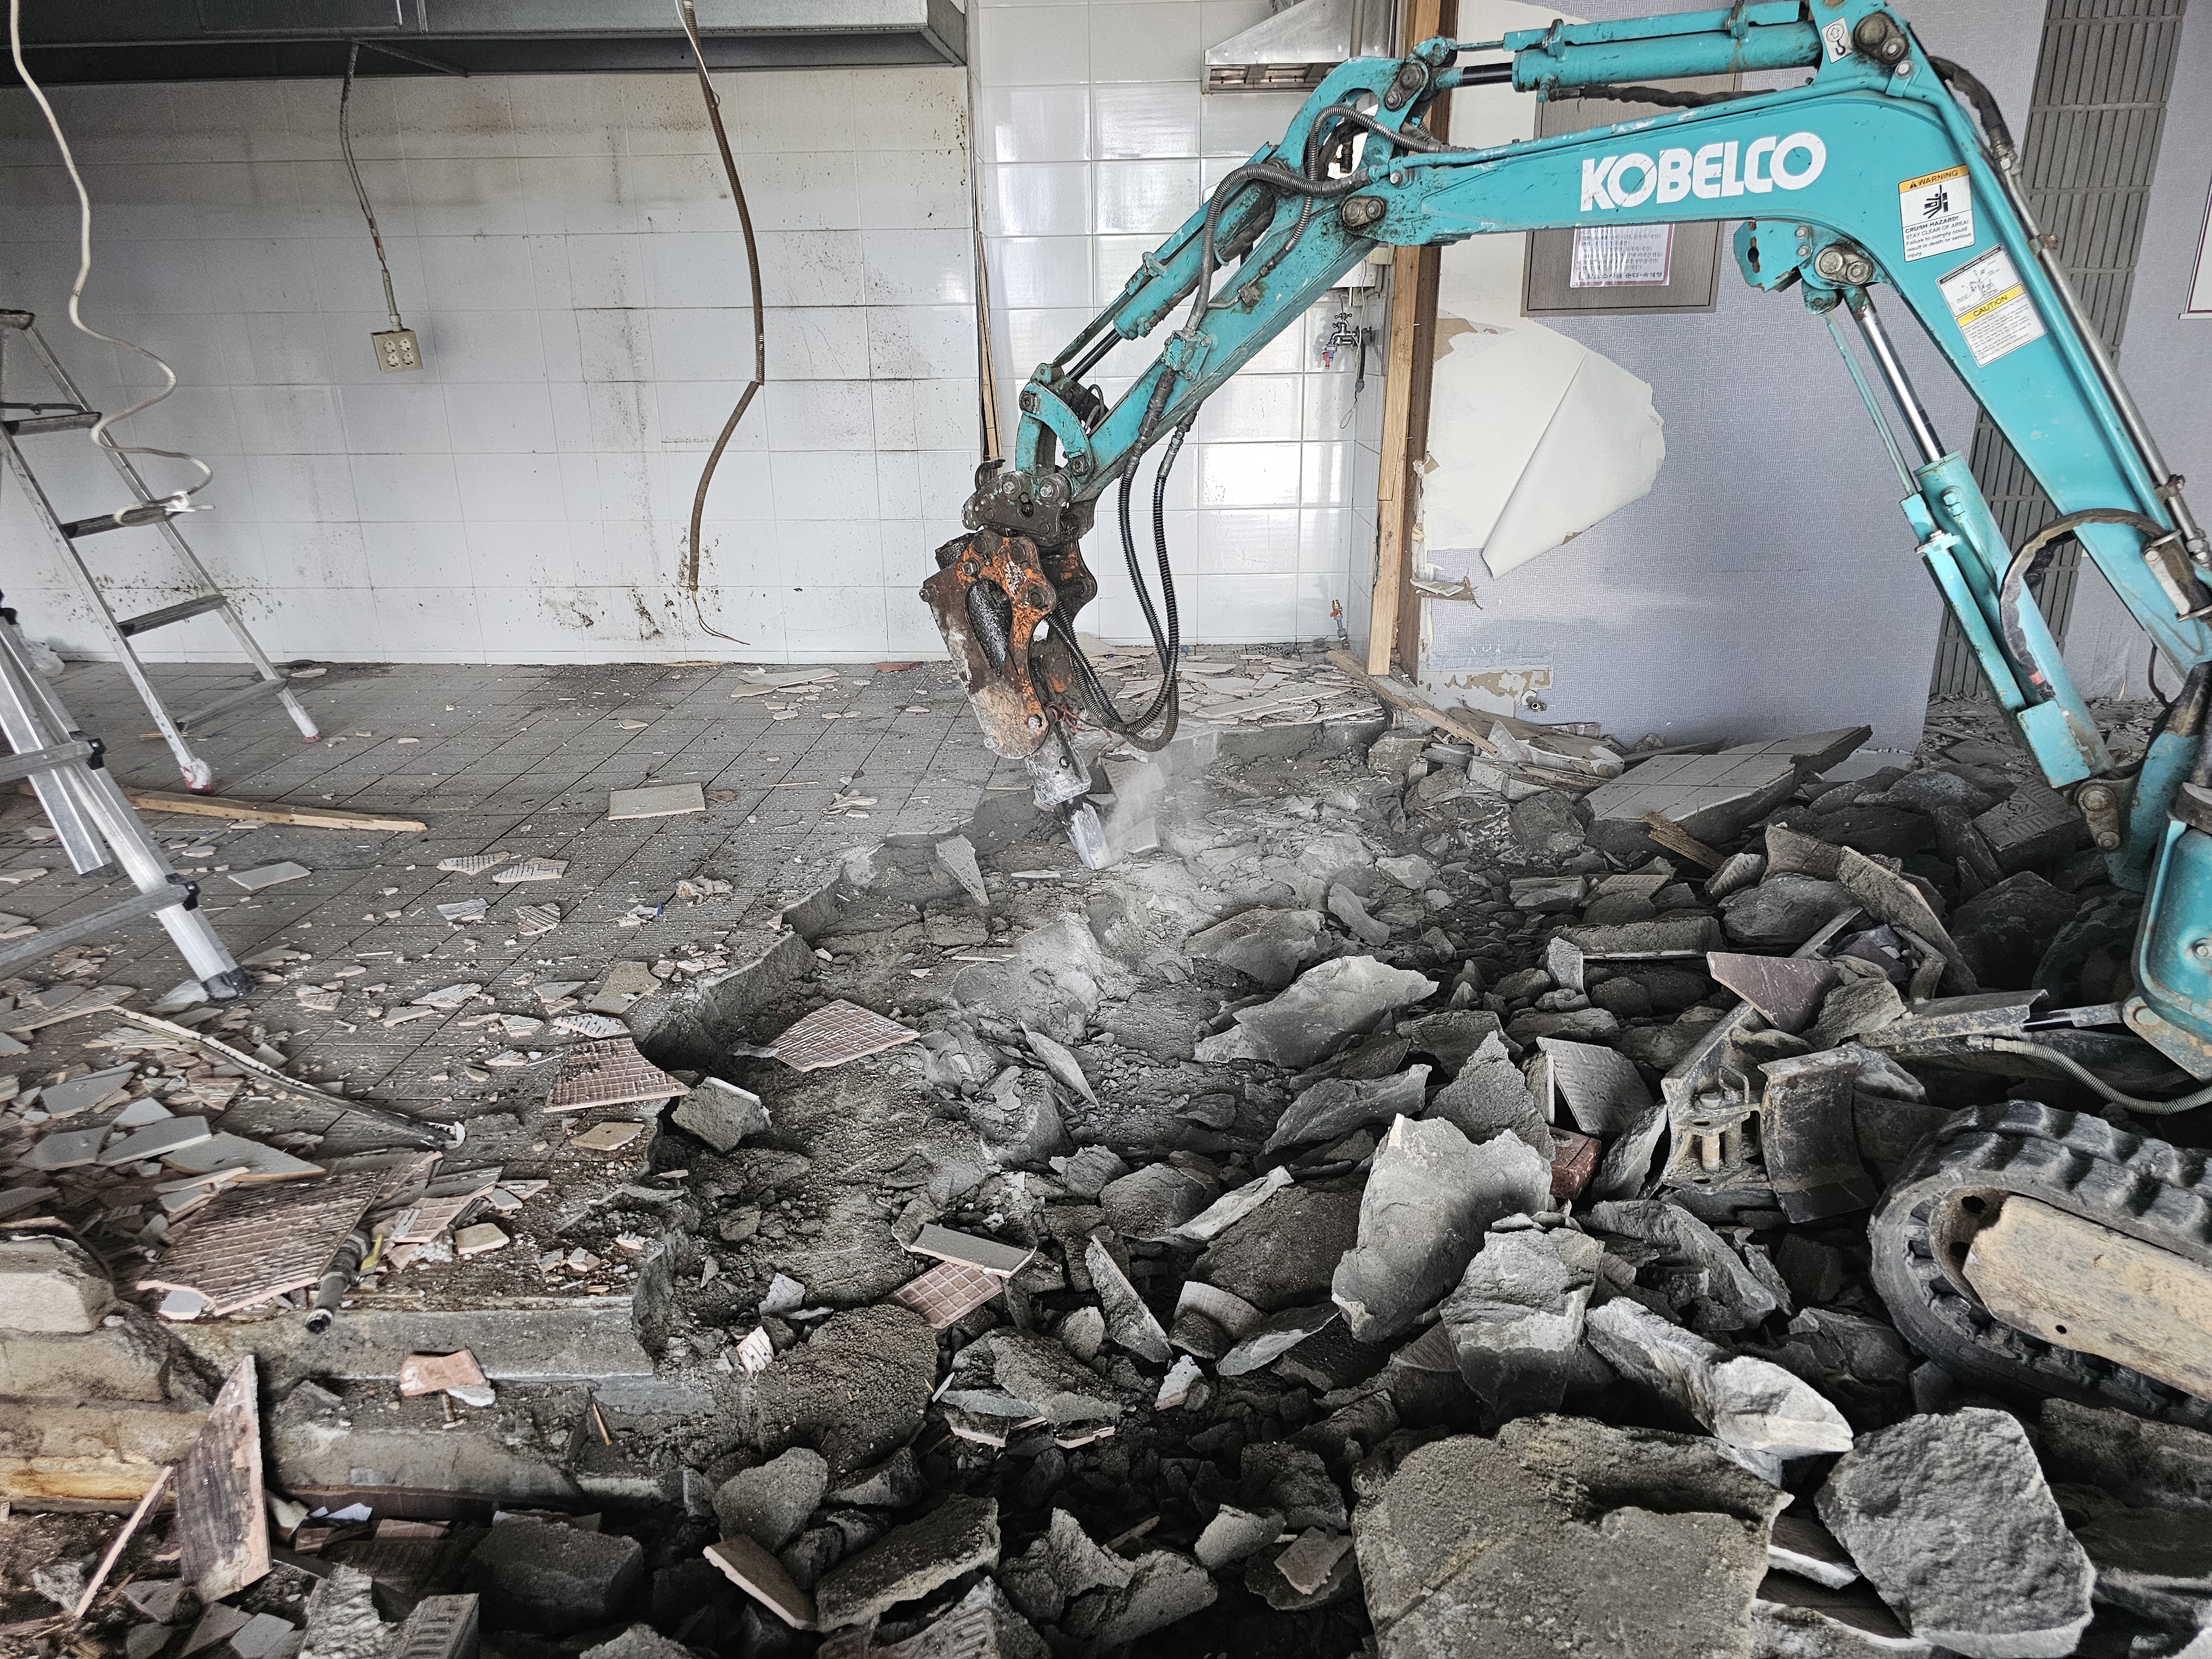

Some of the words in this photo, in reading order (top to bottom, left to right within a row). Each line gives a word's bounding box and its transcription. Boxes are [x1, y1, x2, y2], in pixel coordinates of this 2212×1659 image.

[1580, 132, 1826, 212] KOBELCO
[1918, 170, 1958, 186] WARNING
[1905, 224, 1928, 233] CRUSH
[1930, 215, 1959, 227] HAZARD!
[1922, 227, 1940, 236] CLEAR
[1951, 219, 1969, 228] AREA!
[1932, 230, 1951, 239] comply
[1952, 232, 1971, 241] serious
[1973, 295, 2008, 317] CAUTION
